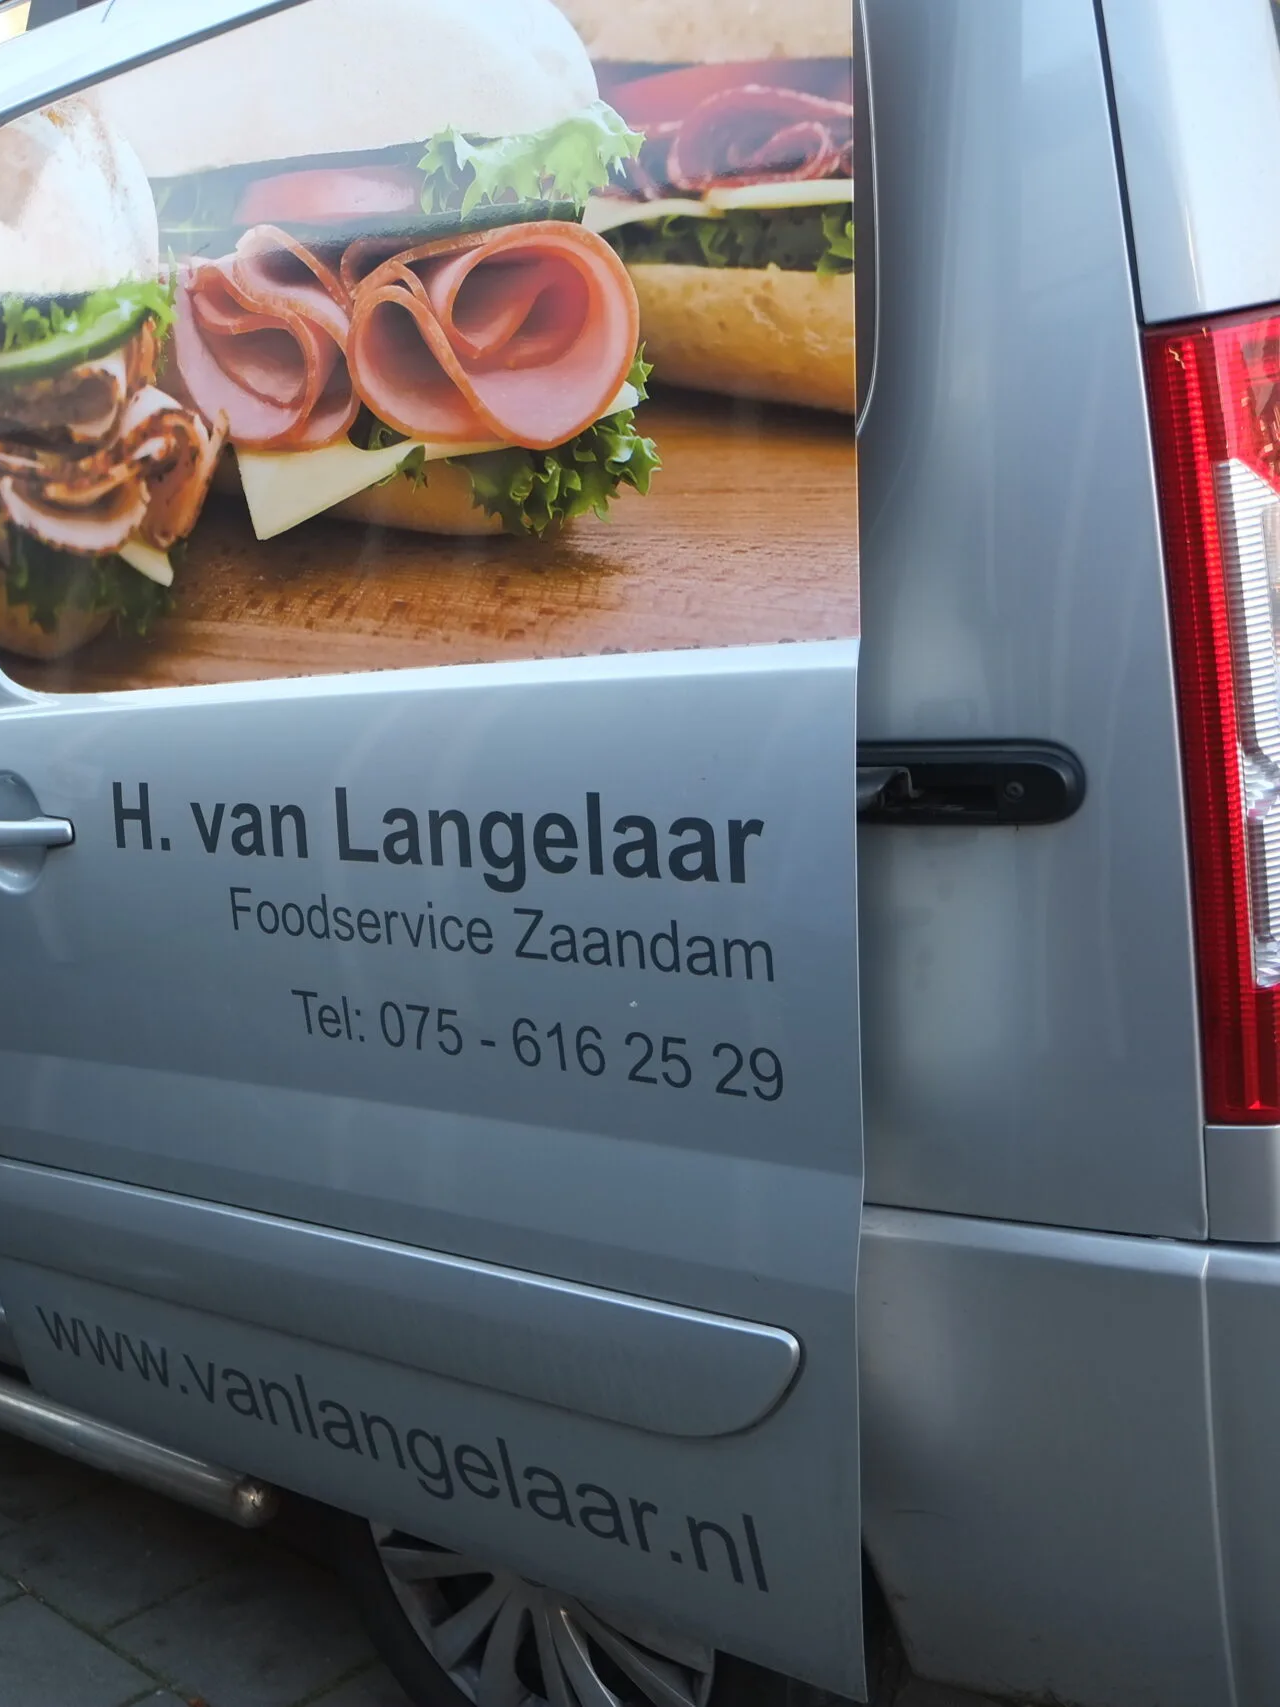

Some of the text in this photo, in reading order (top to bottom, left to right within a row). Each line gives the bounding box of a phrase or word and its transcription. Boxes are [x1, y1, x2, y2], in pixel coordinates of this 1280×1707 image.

[112, 781, 765, 893] H. van Langelaar
[229, 886, 776, 982] Foodservice Zaandam
[291, 989, 366, 1043] Tel:
[380, 1000, 464, 1056] 075
[512, 1017, 607, 1077] 616
[624, 1031, 693, 1089] 25
[712, 1042, 784, 1102] 29
[35, 1304, 770, 1593] www.vanlangelaar.nl
